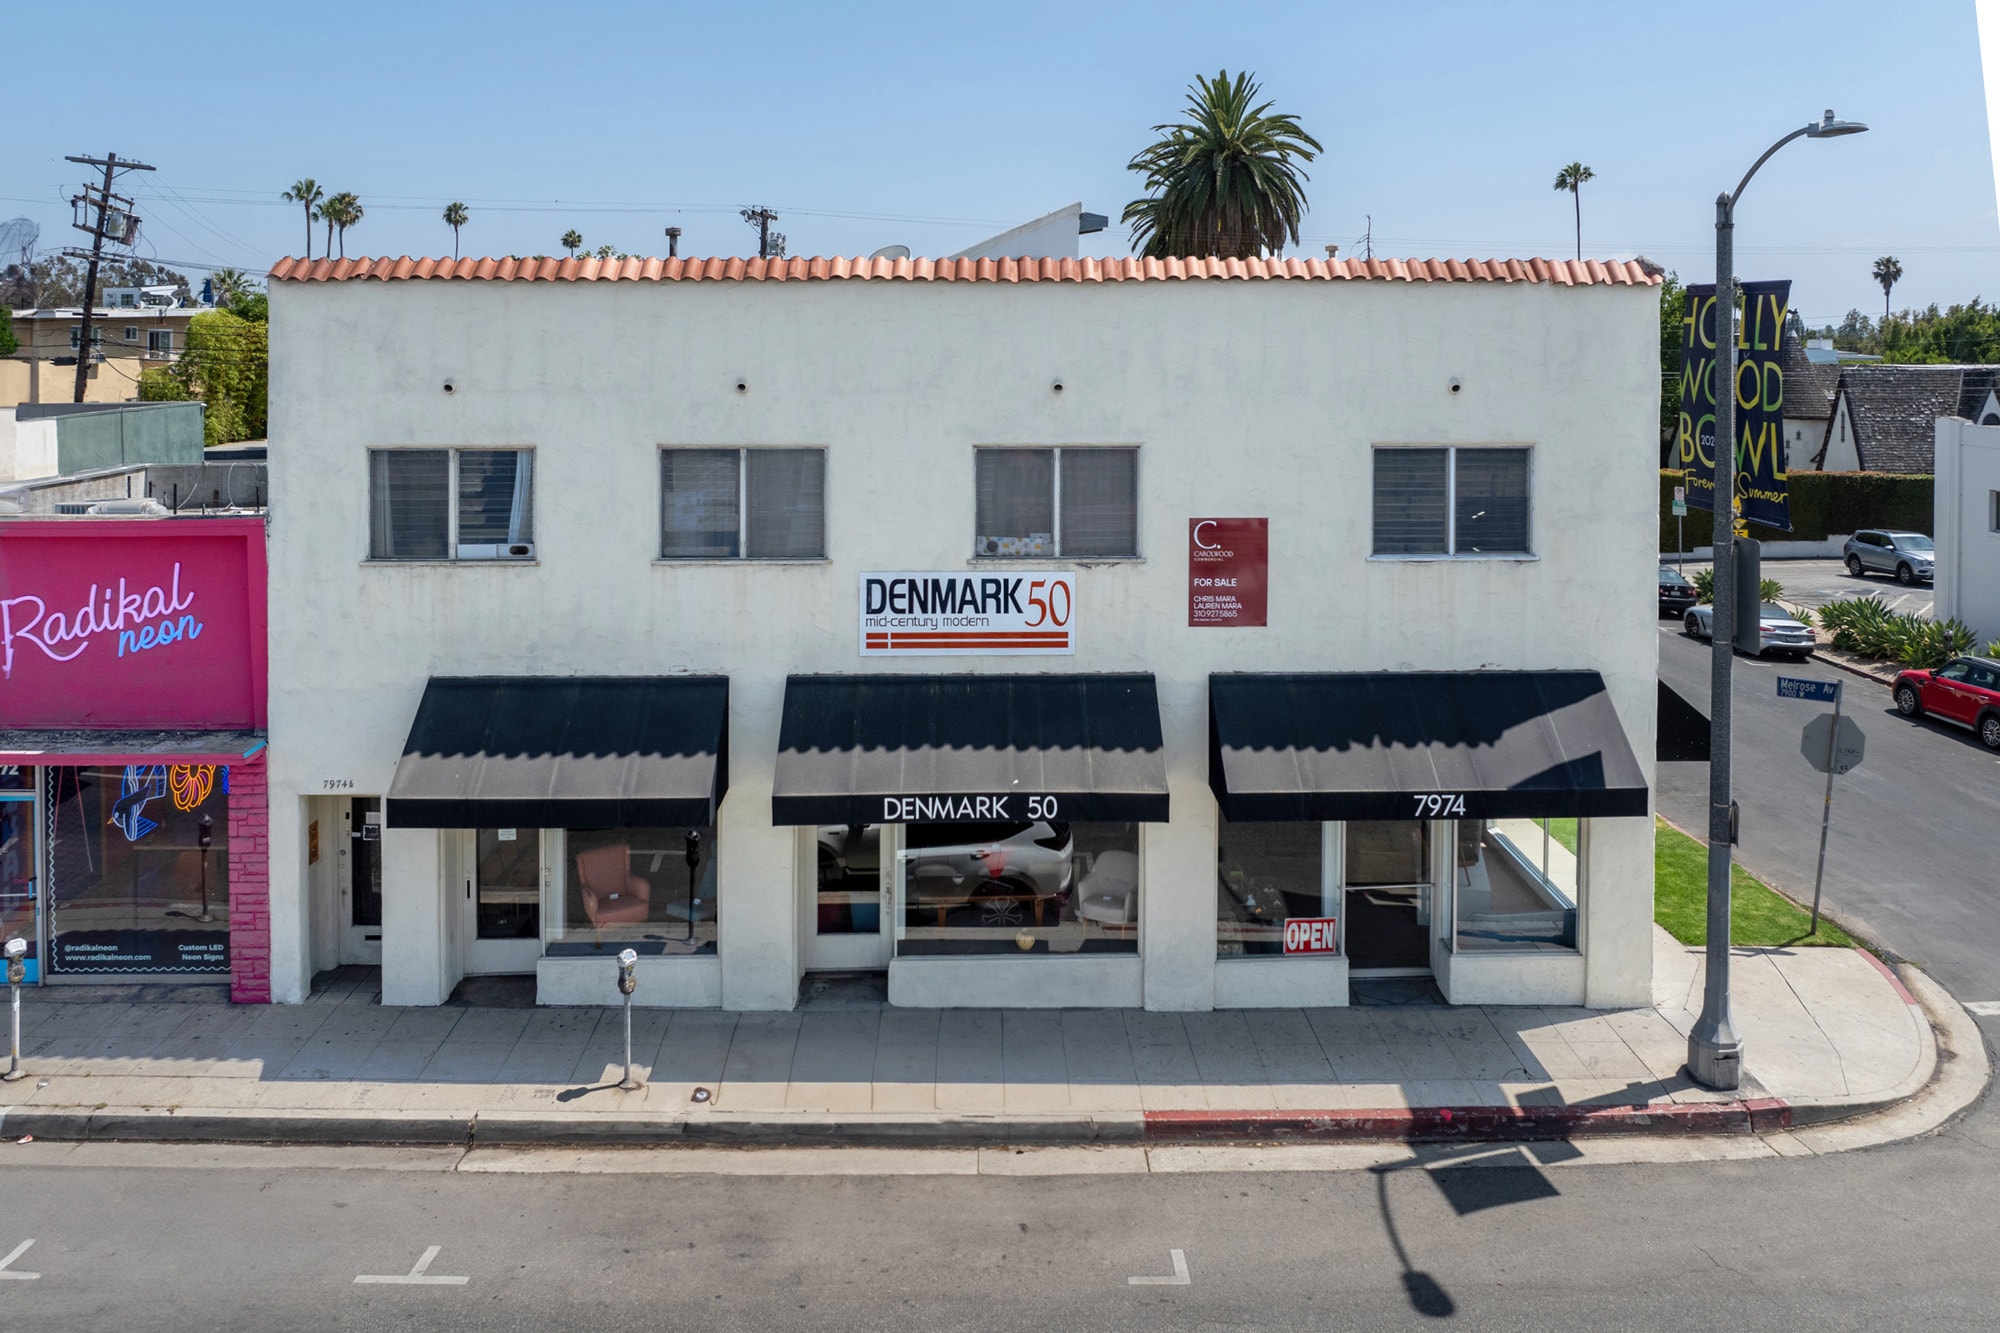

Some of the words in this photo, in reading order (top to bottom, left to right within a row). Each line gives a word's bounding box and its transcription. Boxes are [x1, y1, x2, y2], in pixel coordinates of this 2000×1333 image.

[1684, 294, 1788, 351] HOLLY
[1700, 433, 1715, 447] 202
[1683, 468, 1715, 494] Forev
[1737, 471, 1788, 503] Summer
[1194, 578, 1212, 586] FOR
[1214, 578, 1237, 586] SALE
[866, 578, 1024, 614] DENMARK
[1024, 579, 1071, 627] 50
[0, 562, 195, 679] Radikal
[866, 615, 938, 630] mid-century
[943, 615, 989, 627] modern
[118, 614, 203, 657] neon
[1780, 678, 1816, 692] Melrose
[1823, 684, 1835, 694] Av
[884, 796, 1009, 820] DENMARK
[1027, 796, 1058, 819] 50
[1414, 794, 1466, 816] 7974
[1286, 922, 1335, 950] OPEN
